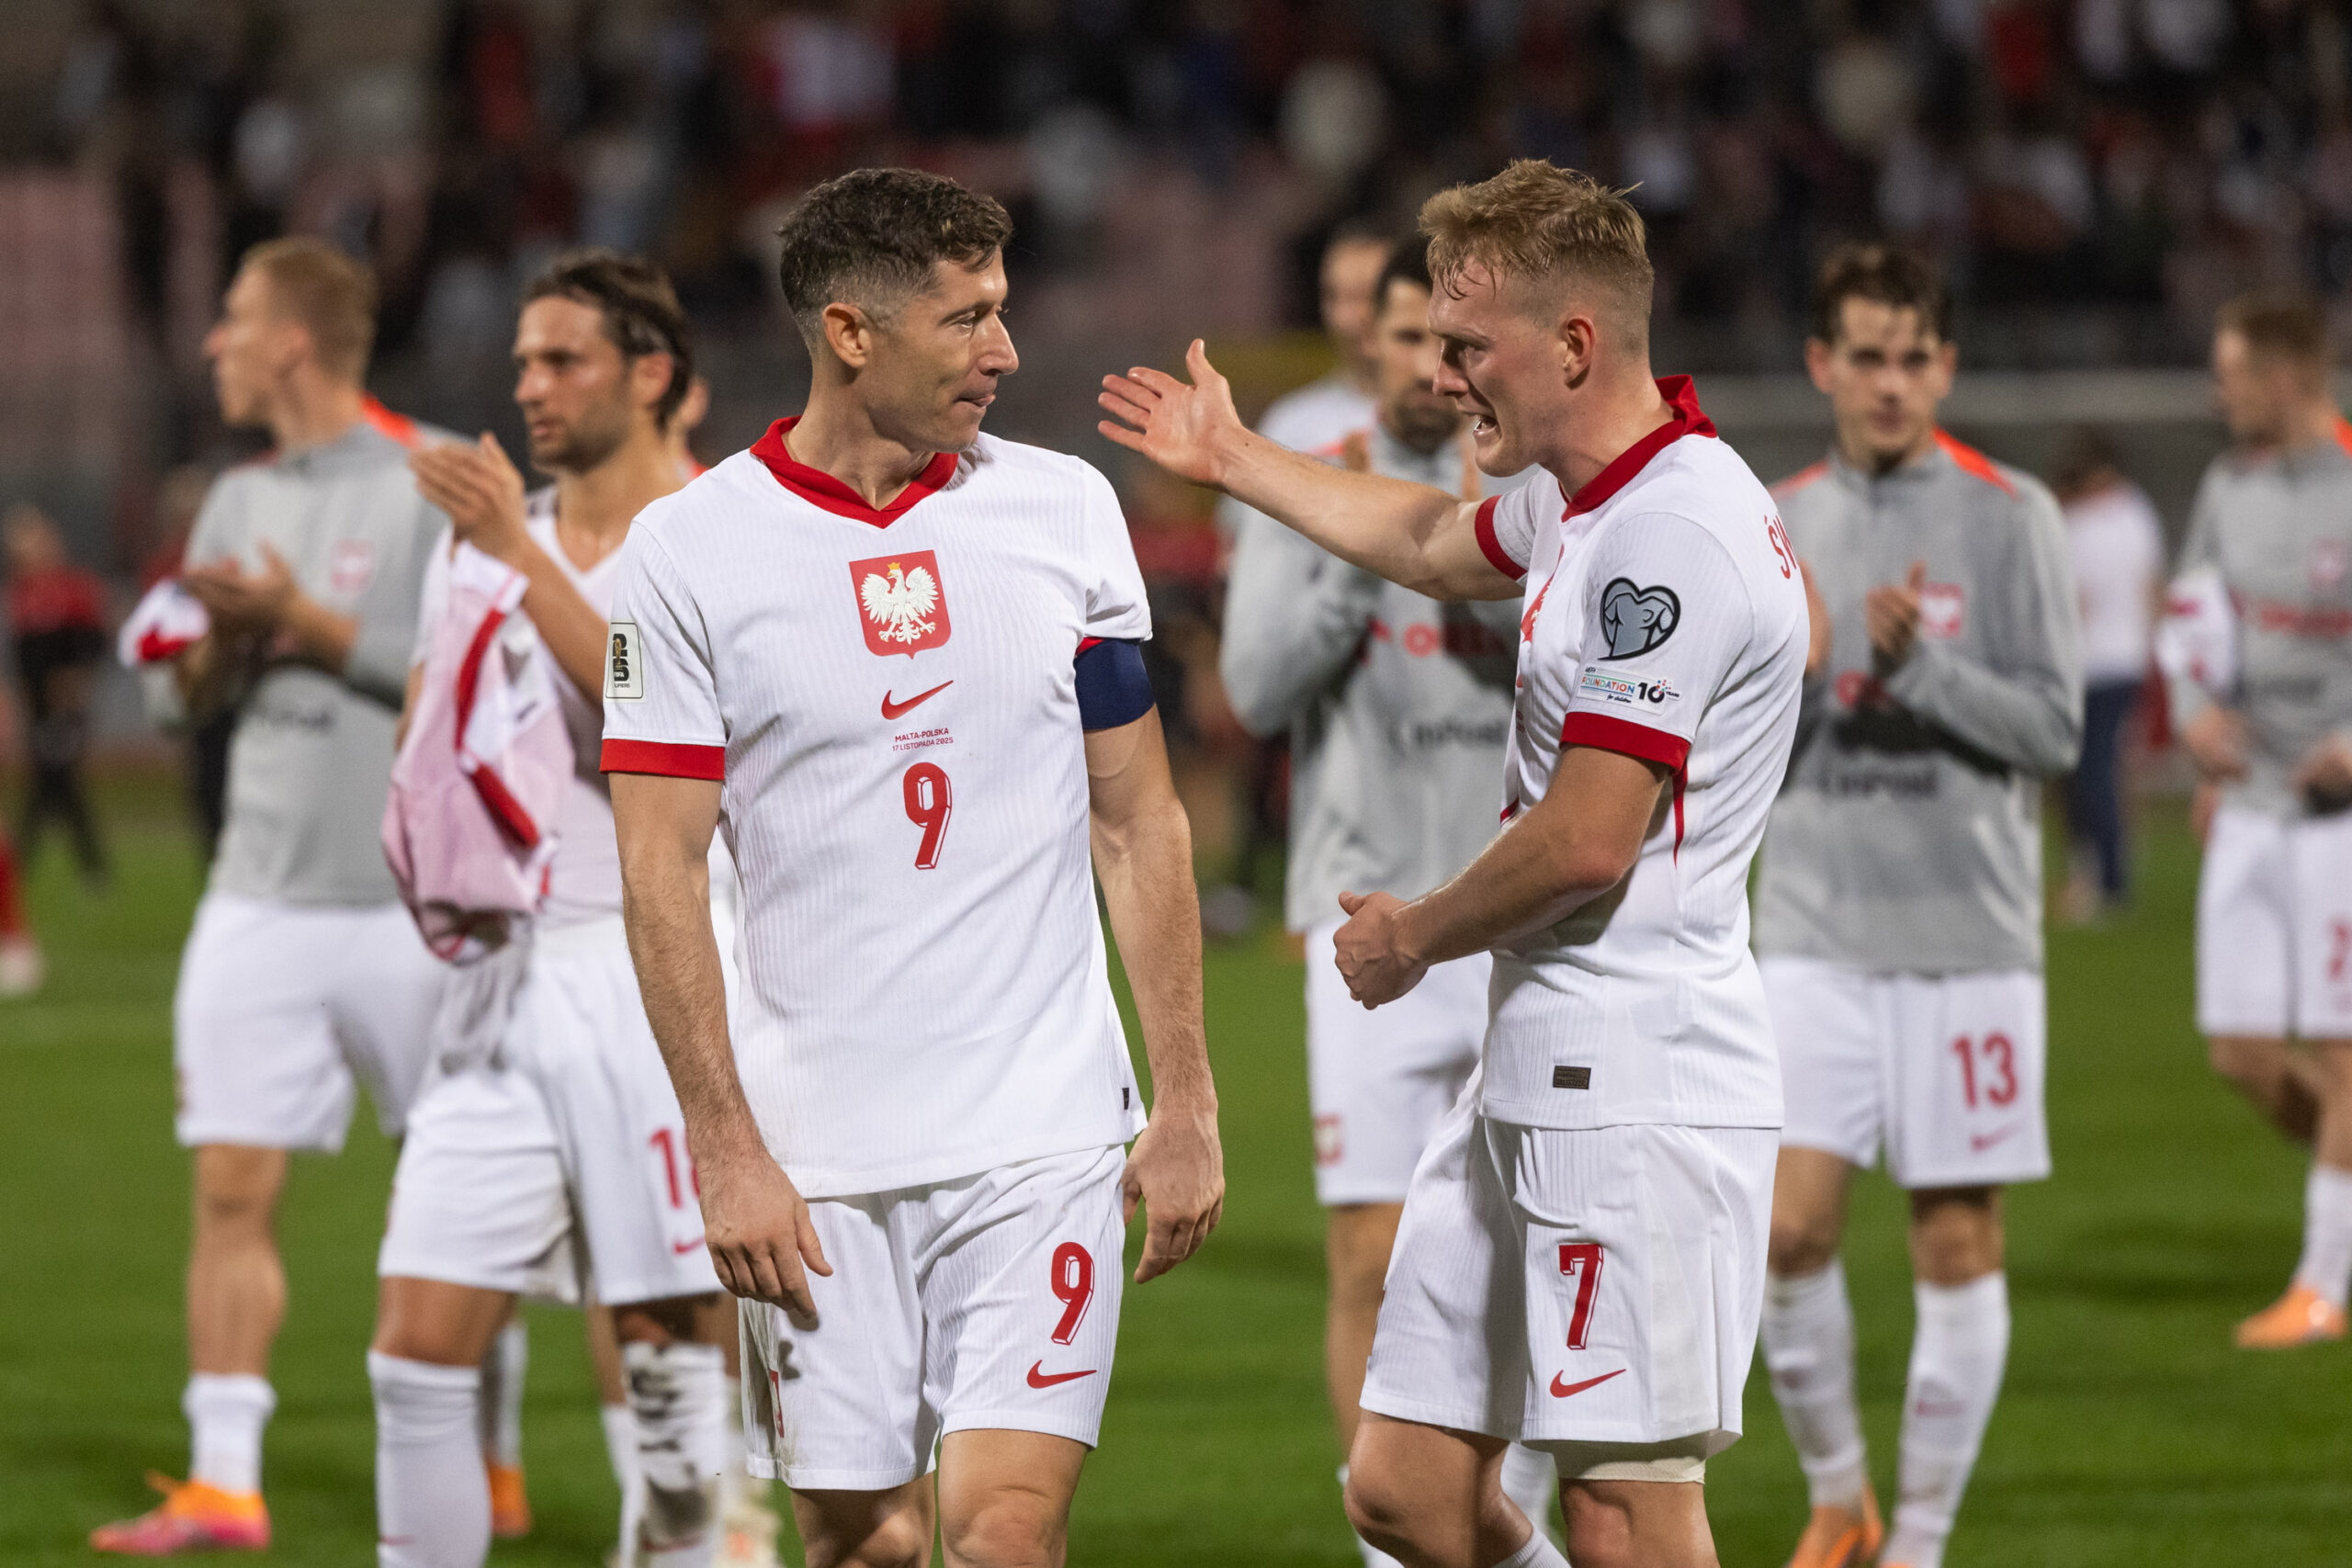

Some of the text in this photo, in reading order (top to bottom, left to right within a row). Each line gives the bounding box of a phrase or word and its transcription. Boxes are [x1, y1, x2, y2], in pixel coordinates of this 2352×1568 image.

[1581, 676, 1635, 694] FOUNDATION
[1638, 682, 1665, 704] 10
[895, 728, 949, 742] MALTA-POLSKA
[900, 739, 935, 750] LISTOPADA
[935, 737, 954, 745] 2025
[903, 761, 952, 870] 9
[1948, 1032, 2018, 1108] 13
[1050, 1241, 1095, 1346] 9
[1558, 1243, 1604, 1350] 7
